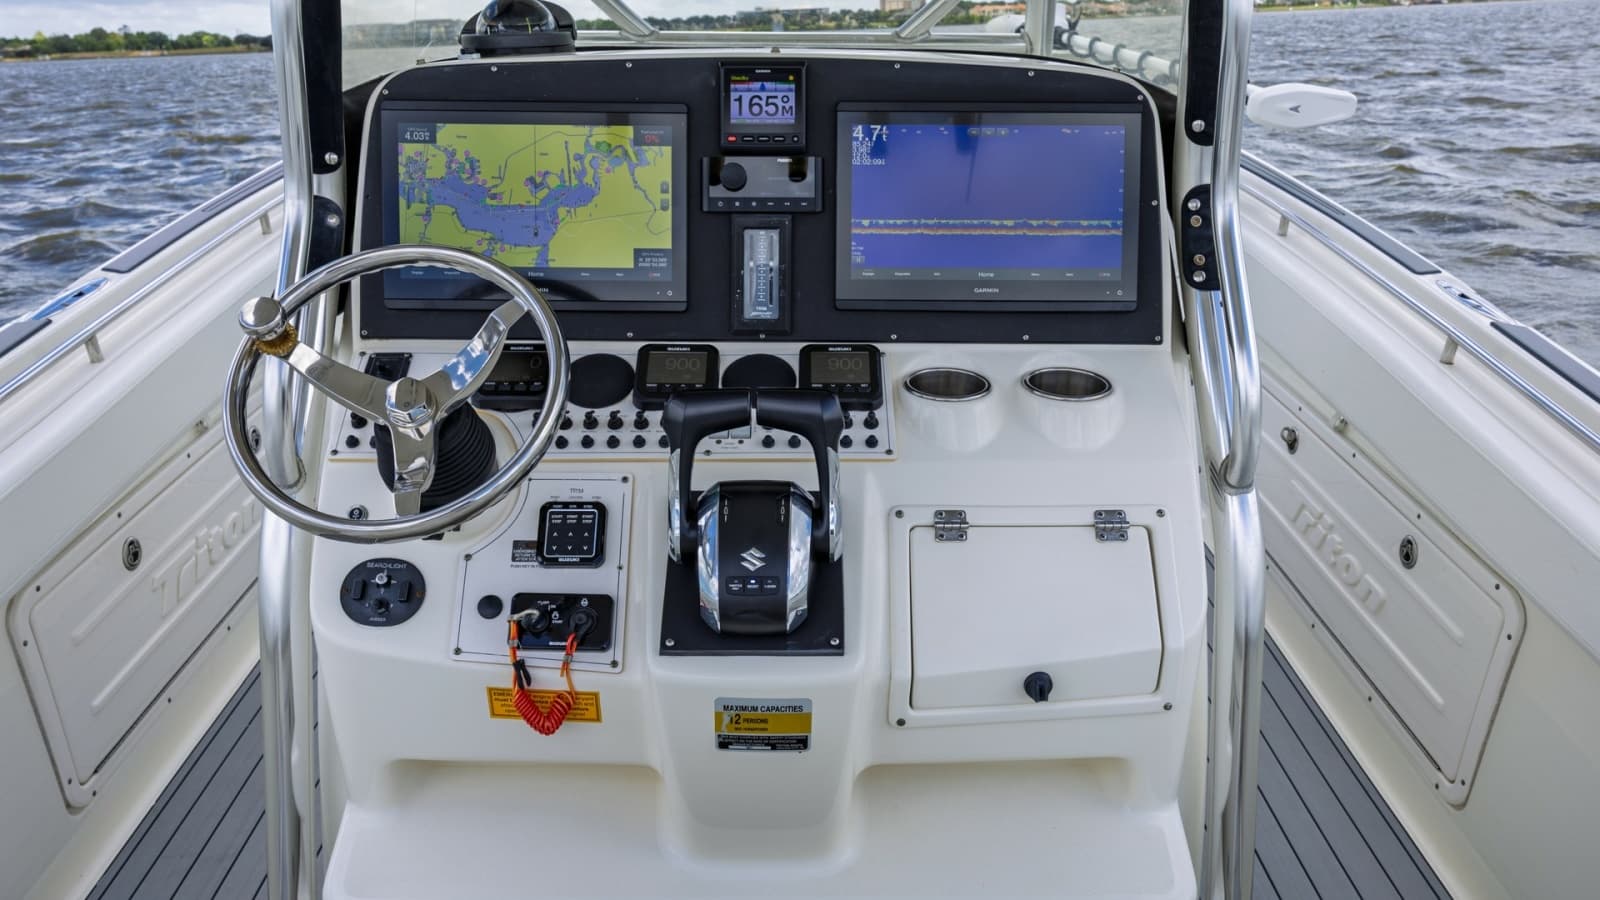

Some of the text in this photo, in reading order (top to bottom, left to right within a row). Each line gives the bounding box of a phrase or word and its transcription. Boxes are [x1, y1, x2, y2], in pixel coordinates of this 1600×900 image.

[665, 357, 701, 370] 900
[828, 358, 863, 371] 900
[723, 704, 804, 713] MAXIMUM CAPACITIES
